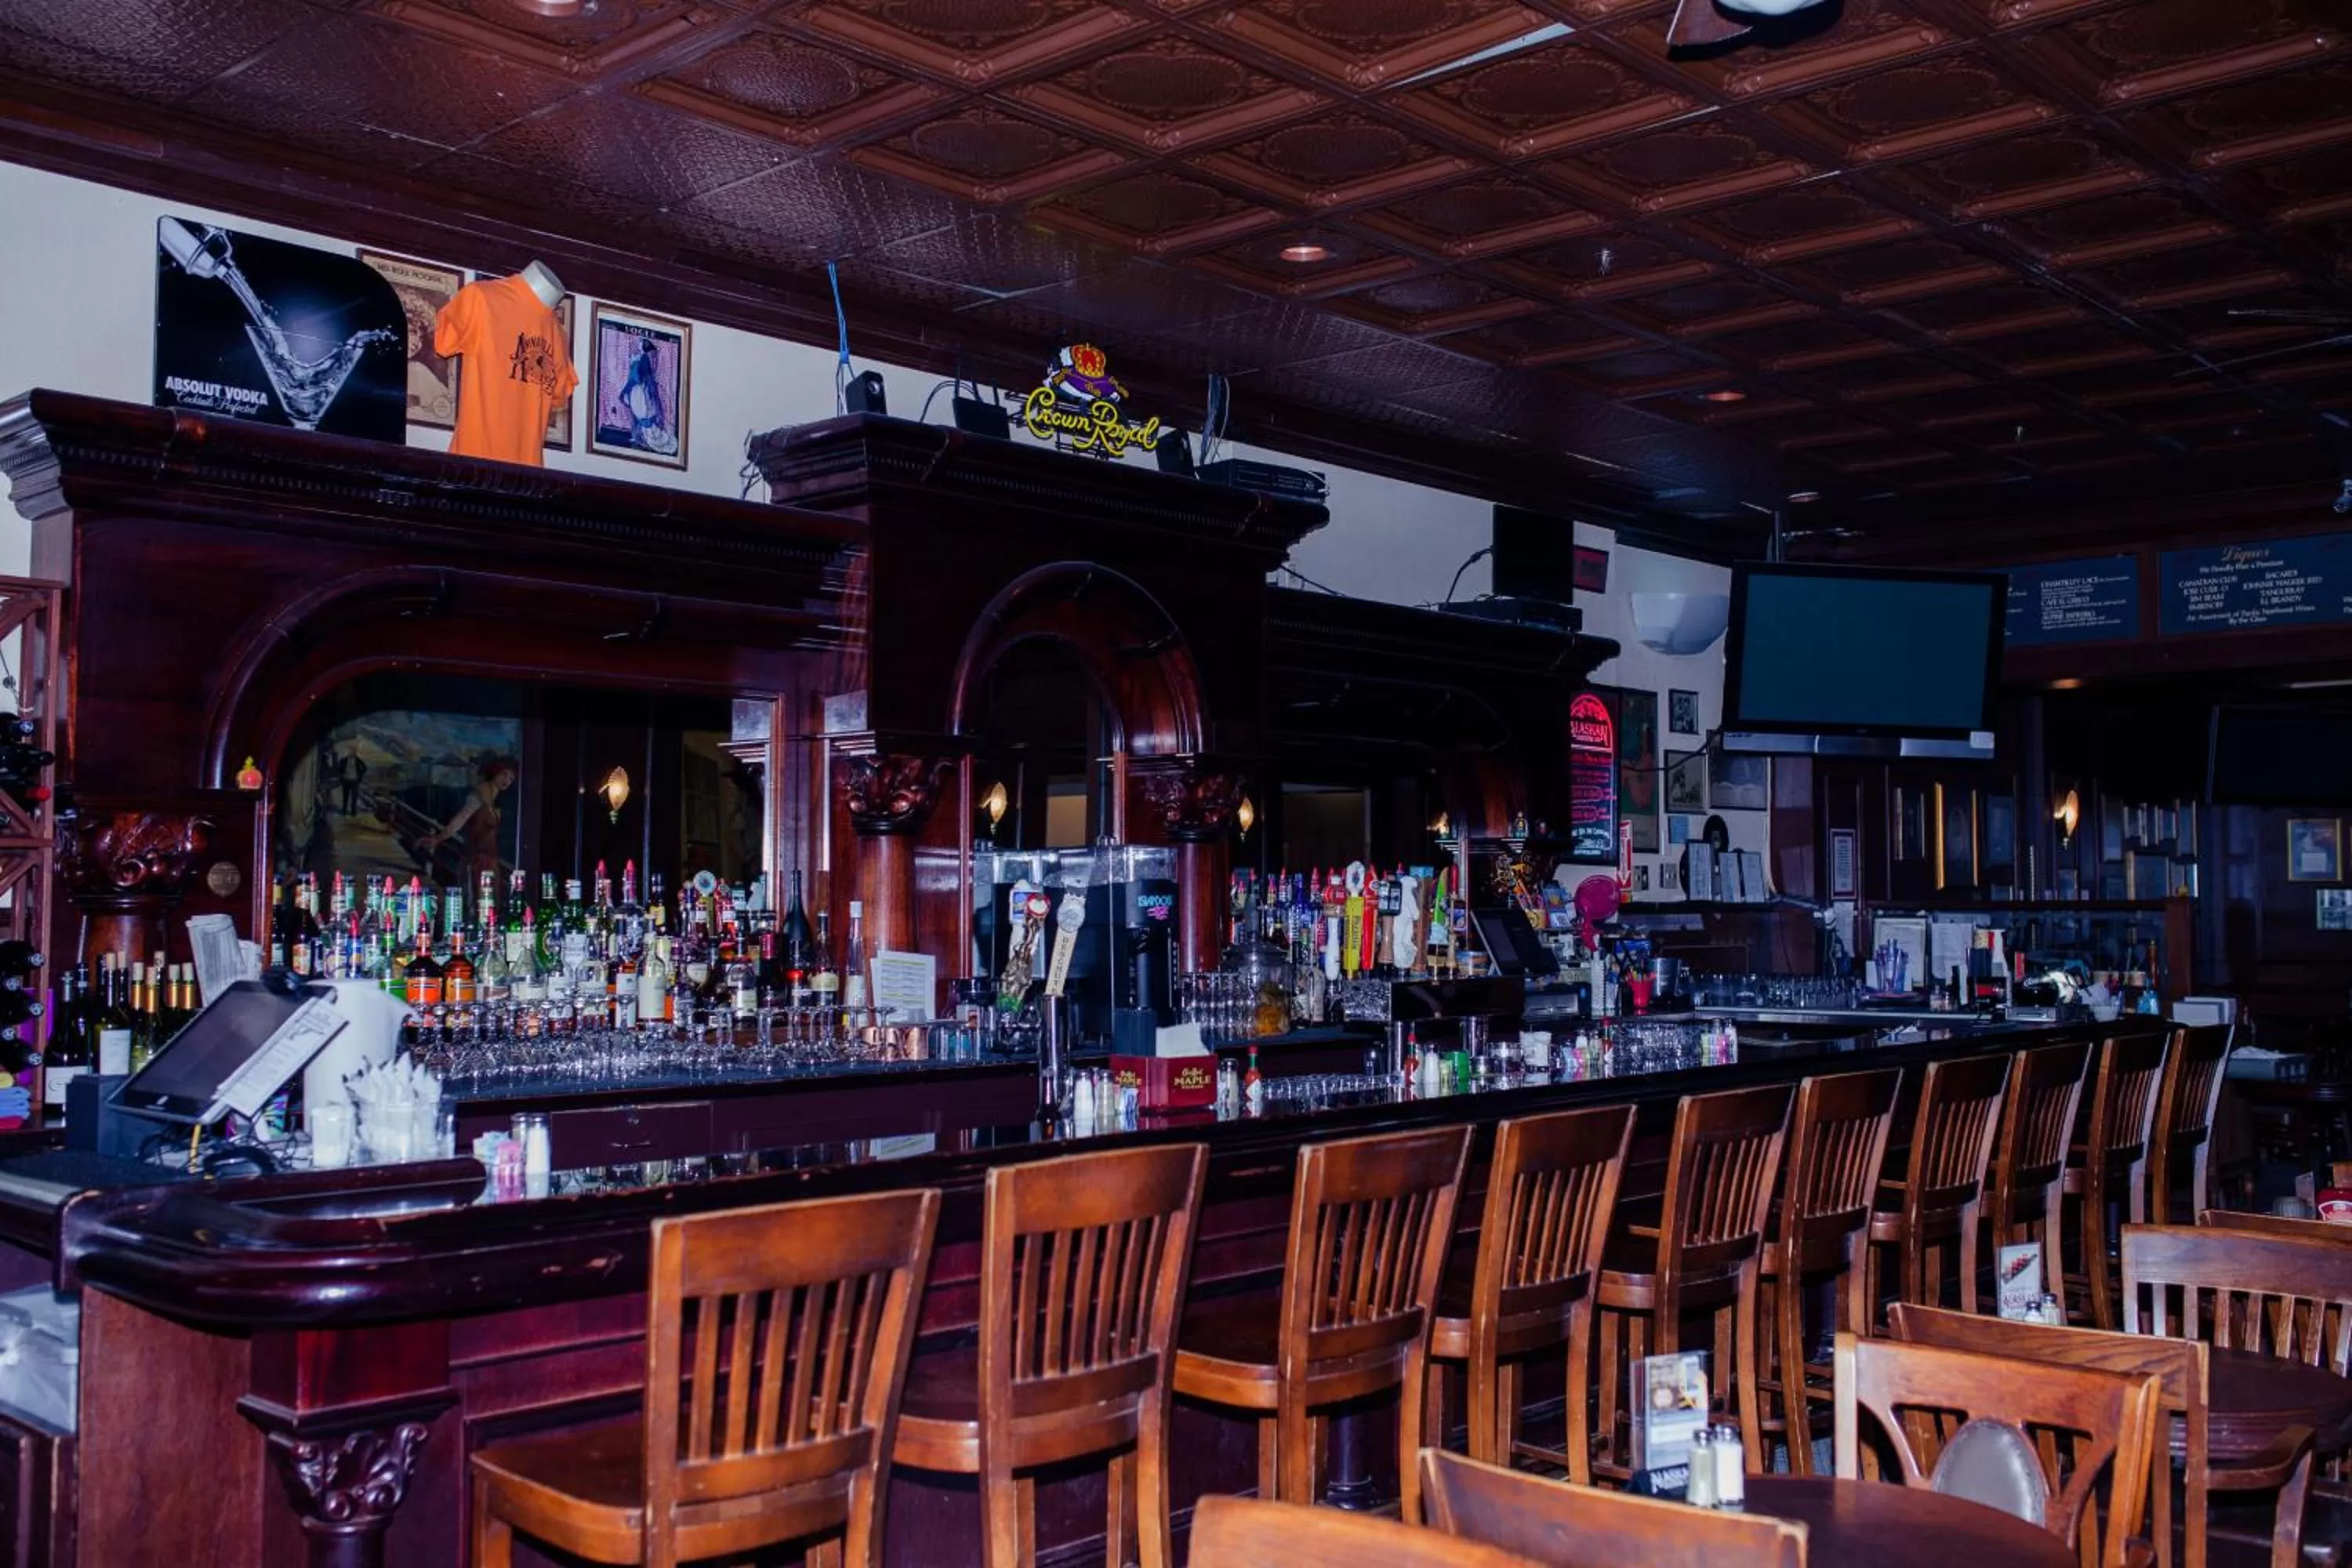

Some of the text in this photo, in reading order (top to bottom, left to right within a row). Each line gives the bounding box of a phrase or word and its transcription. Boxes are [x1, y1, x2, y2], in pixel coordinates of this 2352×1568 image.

[165, 376, 268, 405] ABSOLUT VODKA
[1025, 387, 1160, 456] Crown Royal
[1174, 1075, 1211, 1086] MAPLE
